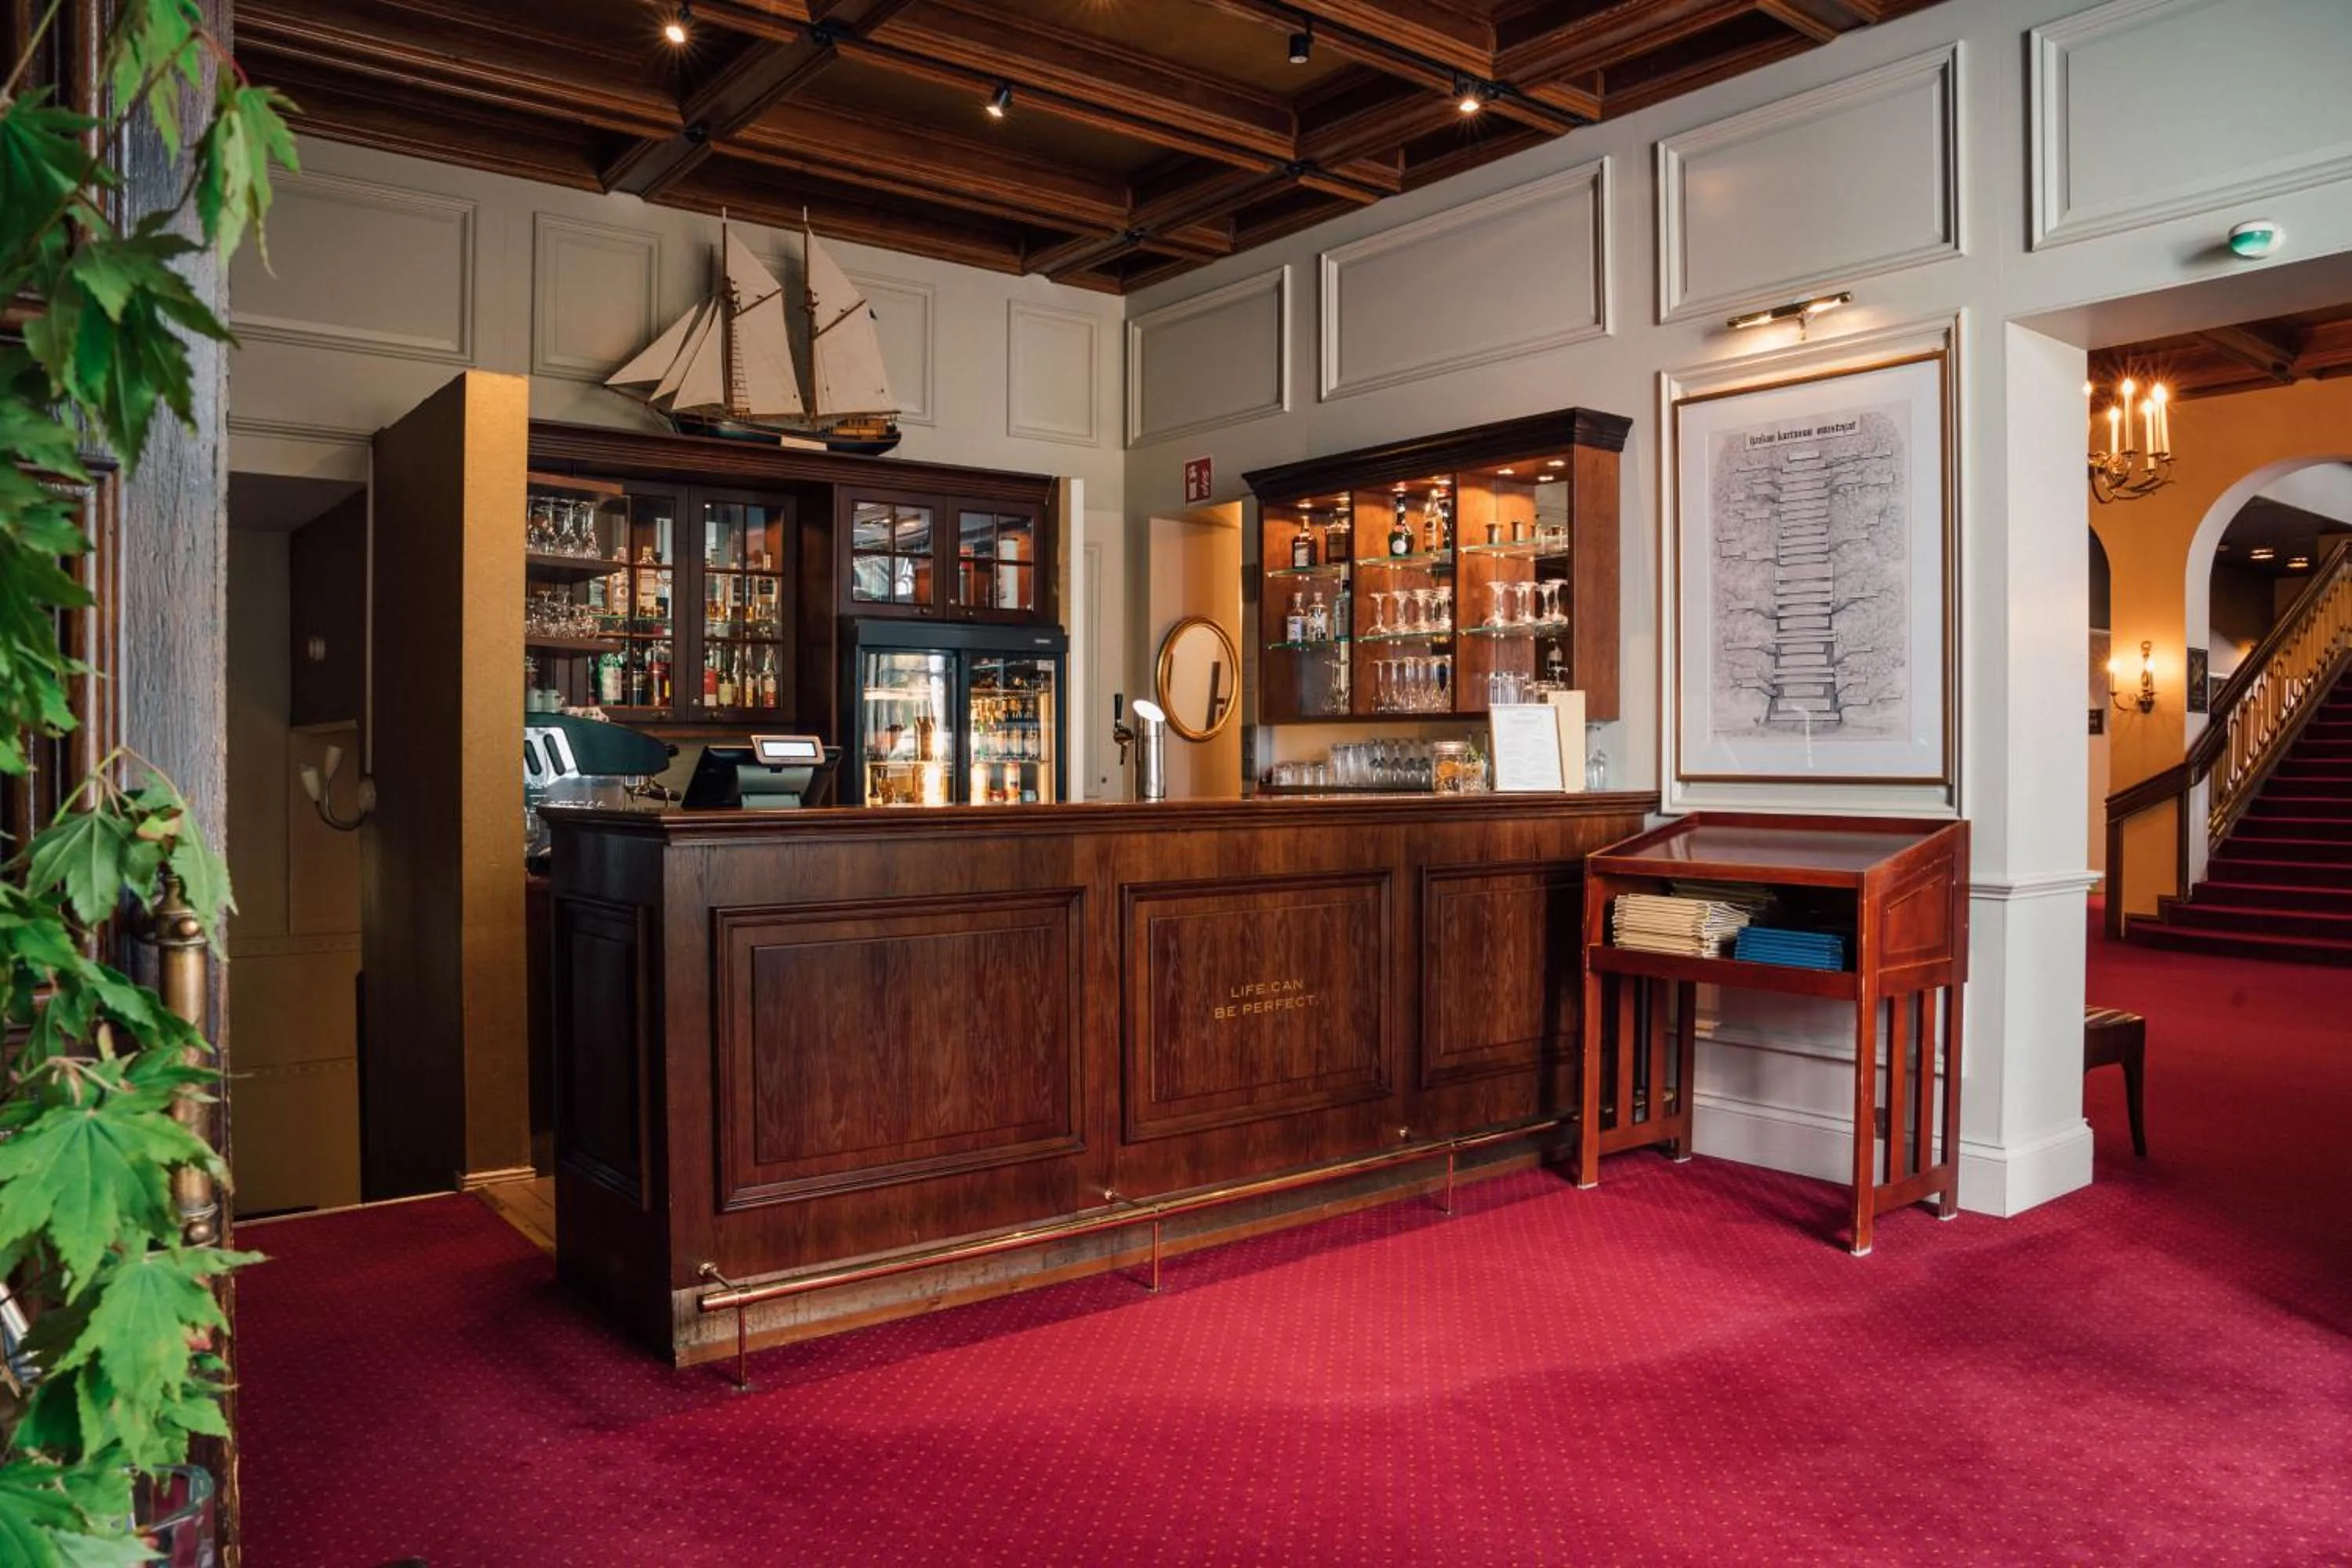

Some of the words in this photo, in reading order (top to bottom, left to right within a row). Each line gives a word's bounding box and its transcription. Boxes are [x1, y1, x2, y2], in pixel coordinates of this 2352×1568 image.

[1230, 984, 1266, 998] LIFE
[1271, 979, 1304, 993] CAN
[1214, 1005, 1236, 1019] BE
